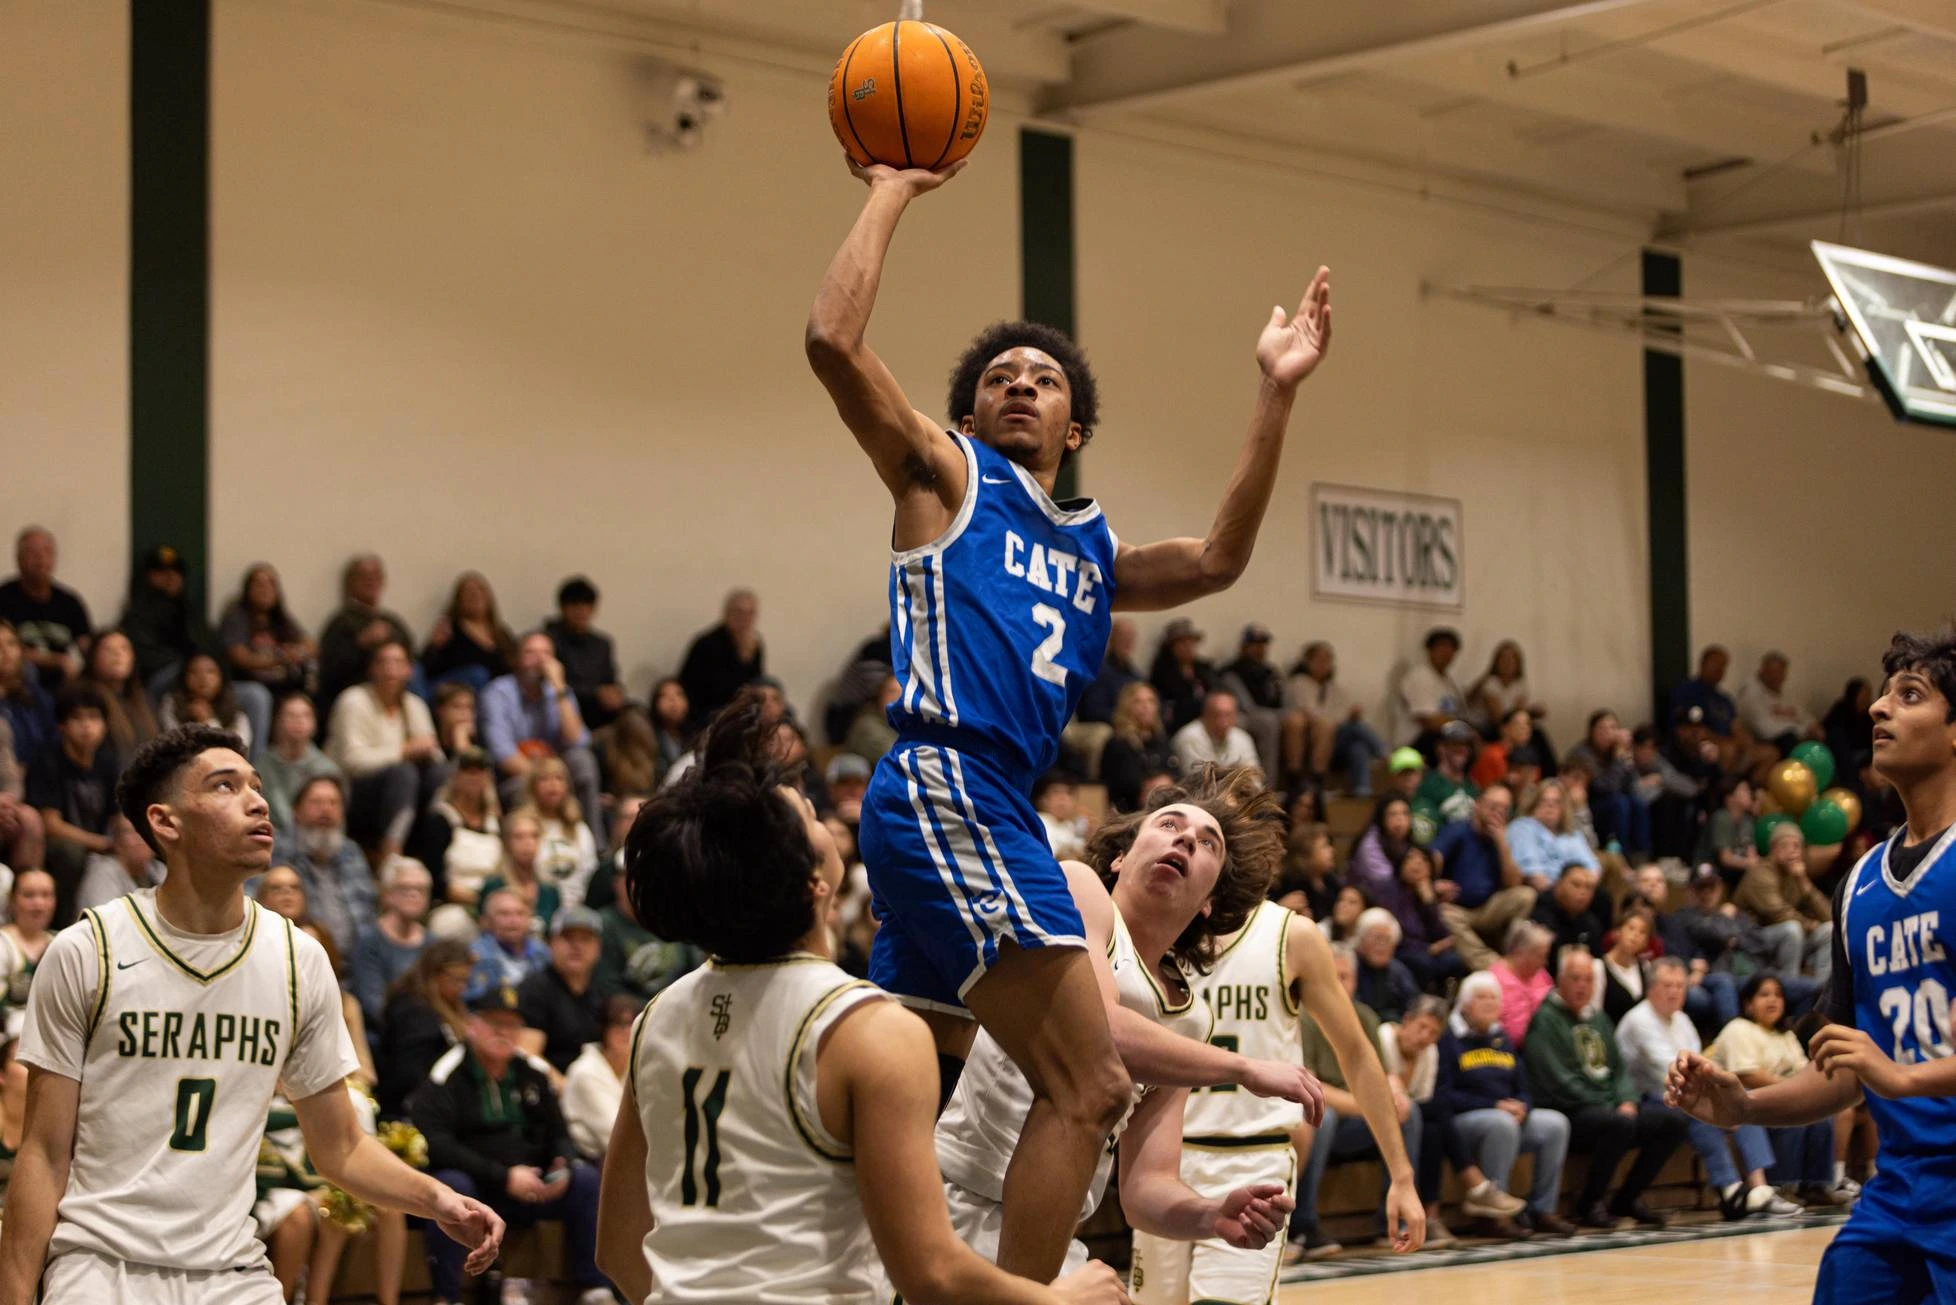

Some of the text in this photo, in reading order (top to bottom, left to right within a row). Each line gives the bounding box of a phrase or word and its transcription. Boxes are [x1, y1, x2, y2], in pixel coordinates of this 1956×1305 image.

[1004, 529, 1103, 615] CATE
[1320, 502, 1458, 589] VISITORS
[1031, 602, 1068, 688] 2
[1866, 911, 1946, 976] CATE
[118, 1011, 280, 1067] SERAPHS
[1879, 978, 1955, 1064] 20
[168, 1077, 217, 1152] 0
[682, 1066, 731, 1207] 11
